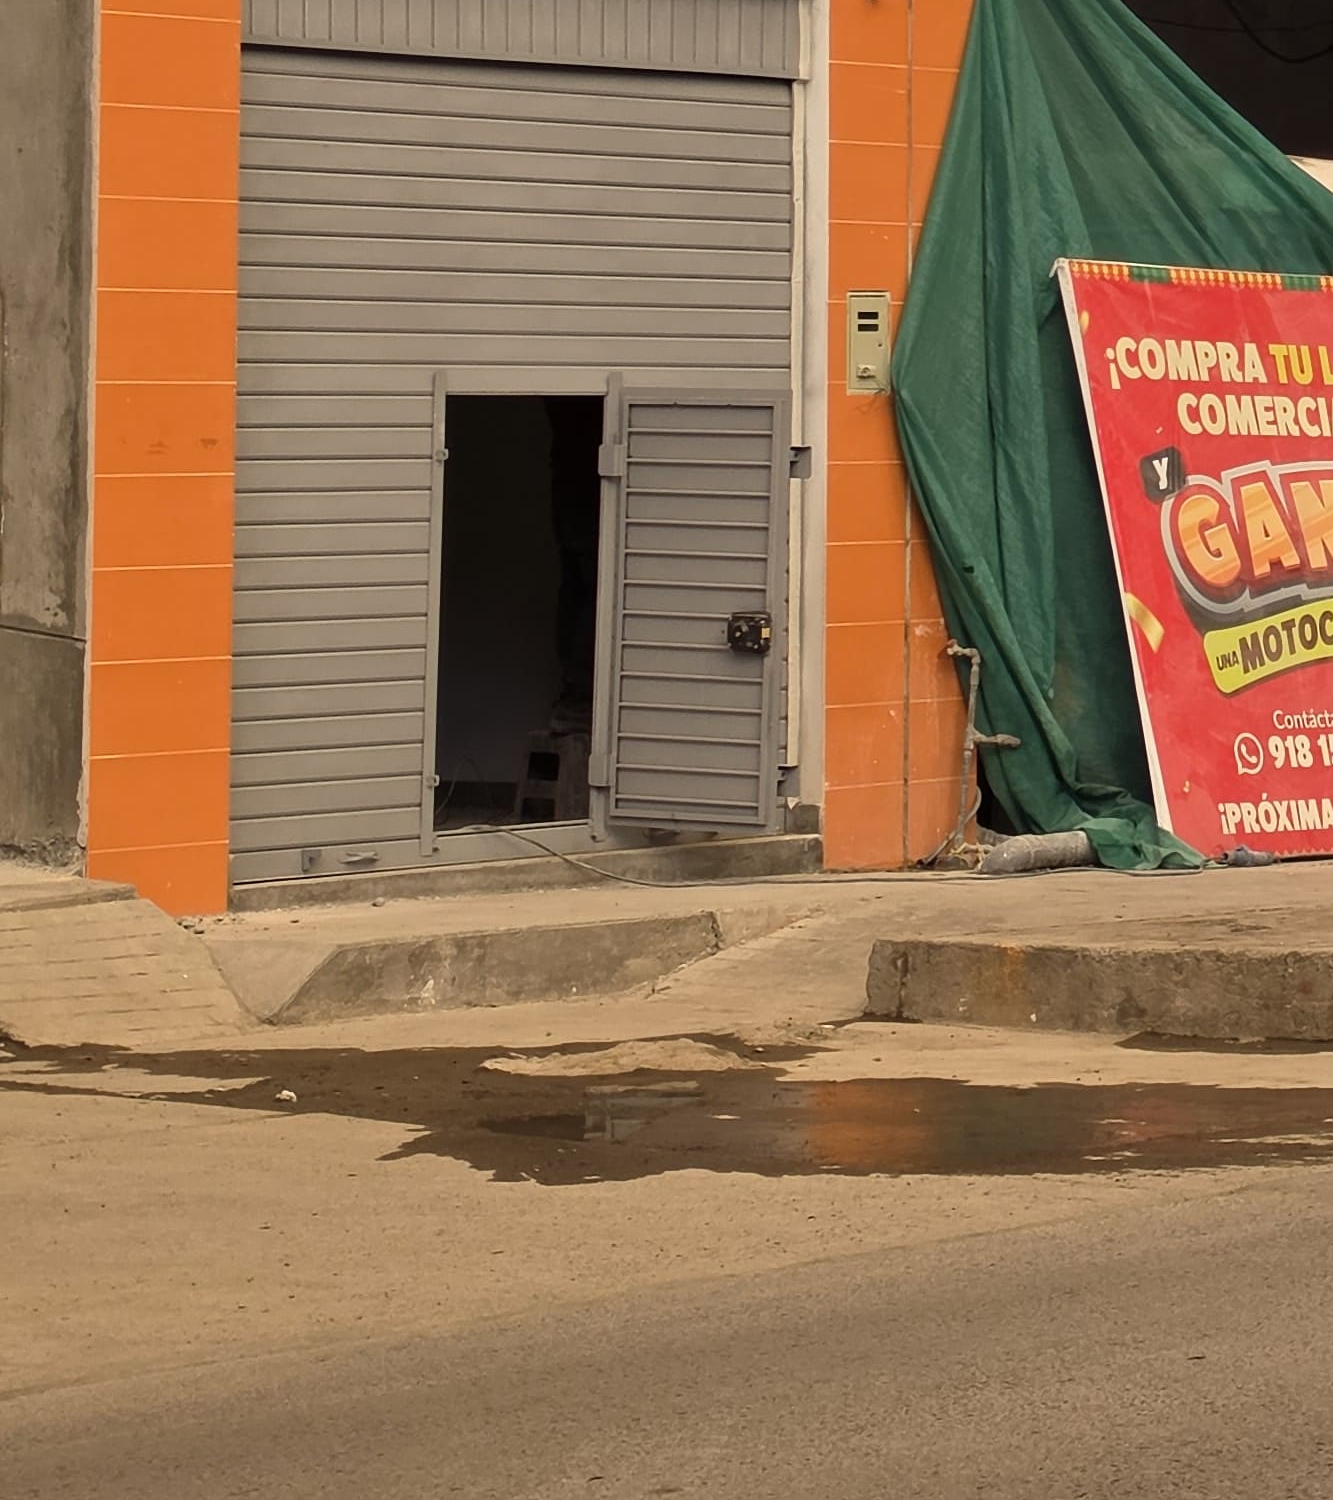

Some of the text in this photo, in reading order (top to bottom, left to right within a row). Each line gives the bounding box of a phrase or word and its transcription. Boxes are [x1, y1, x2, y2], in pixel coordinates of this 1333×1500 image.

[1104, 336, 1268, 390] ¡COMPRA
[1268, 343, 1315, 385] TU
[1215, 650, 1240, 671] UNA
[1268, 734, 1314, 769] 918
